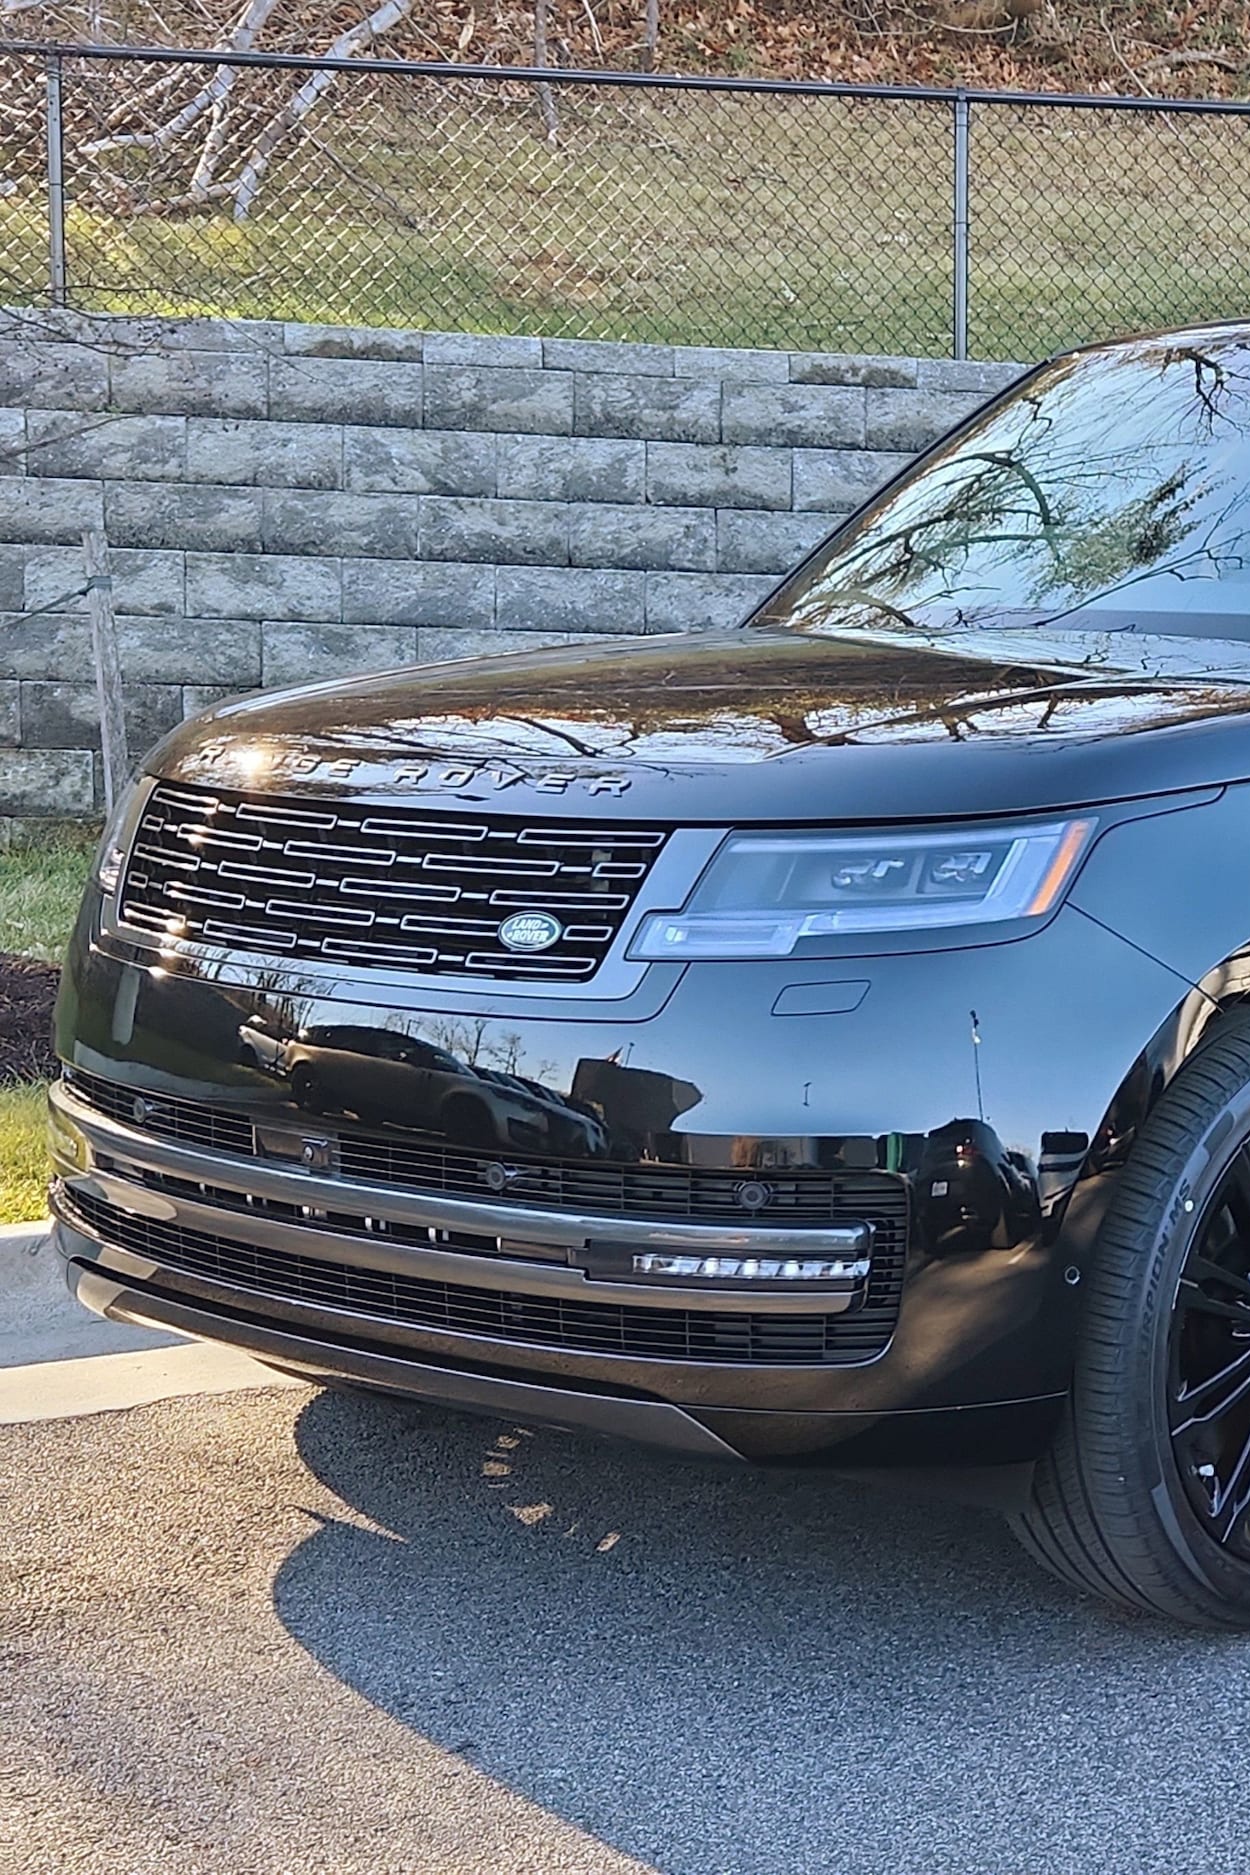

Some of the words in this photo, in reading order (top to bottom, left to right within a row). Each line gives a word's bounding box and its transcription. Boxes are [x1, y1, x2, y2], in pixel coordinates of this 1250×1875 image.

[199, 744, 362, 779] RGE
[393, 766, 632, 797] ROVER
[511, 918, 543, 930] LAND
[510, 929, 550, 942] ROVER
